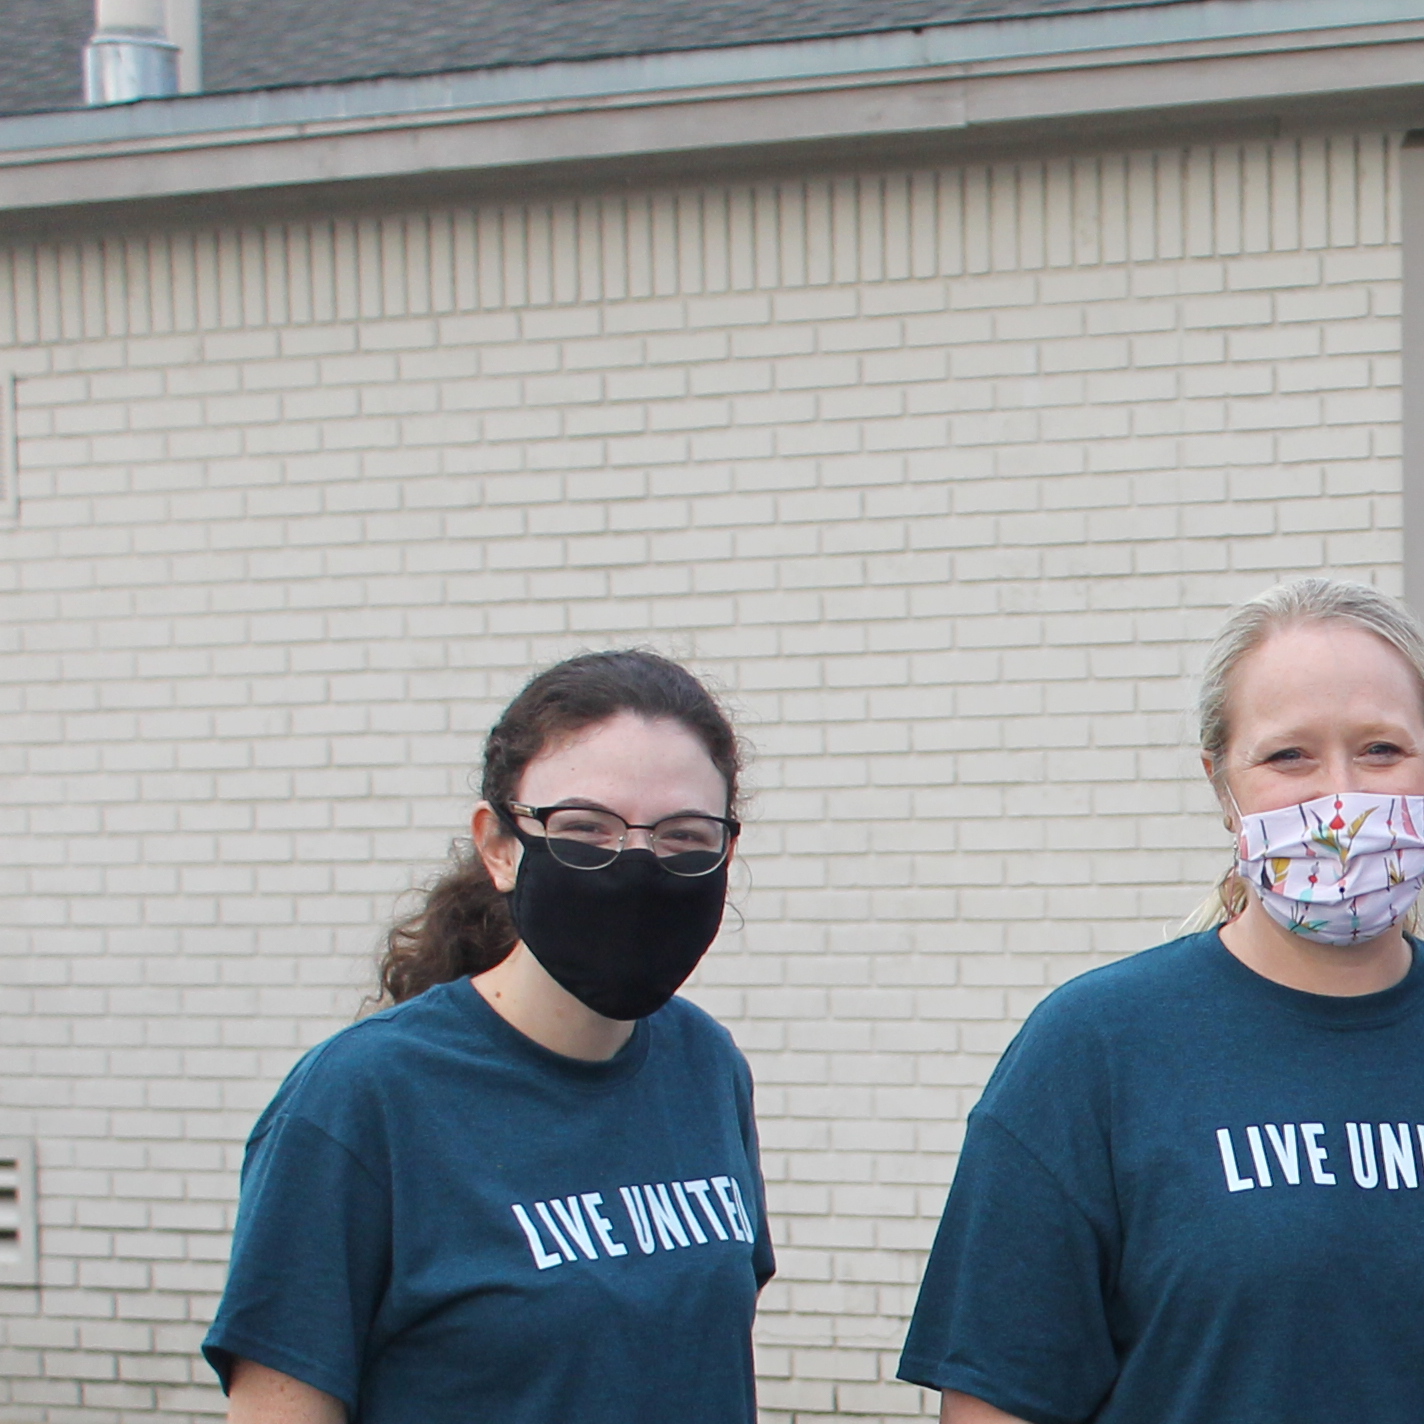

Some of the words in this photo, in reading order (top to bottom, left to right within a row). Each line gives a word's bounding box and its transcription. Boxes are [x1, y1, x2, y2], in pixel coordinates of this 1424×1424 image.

[1216, 1122, 1336, 1193] LIVE
[511, 1191, 628, 1270] LIVE
[619, 1175, 754, 1255] UNITED
